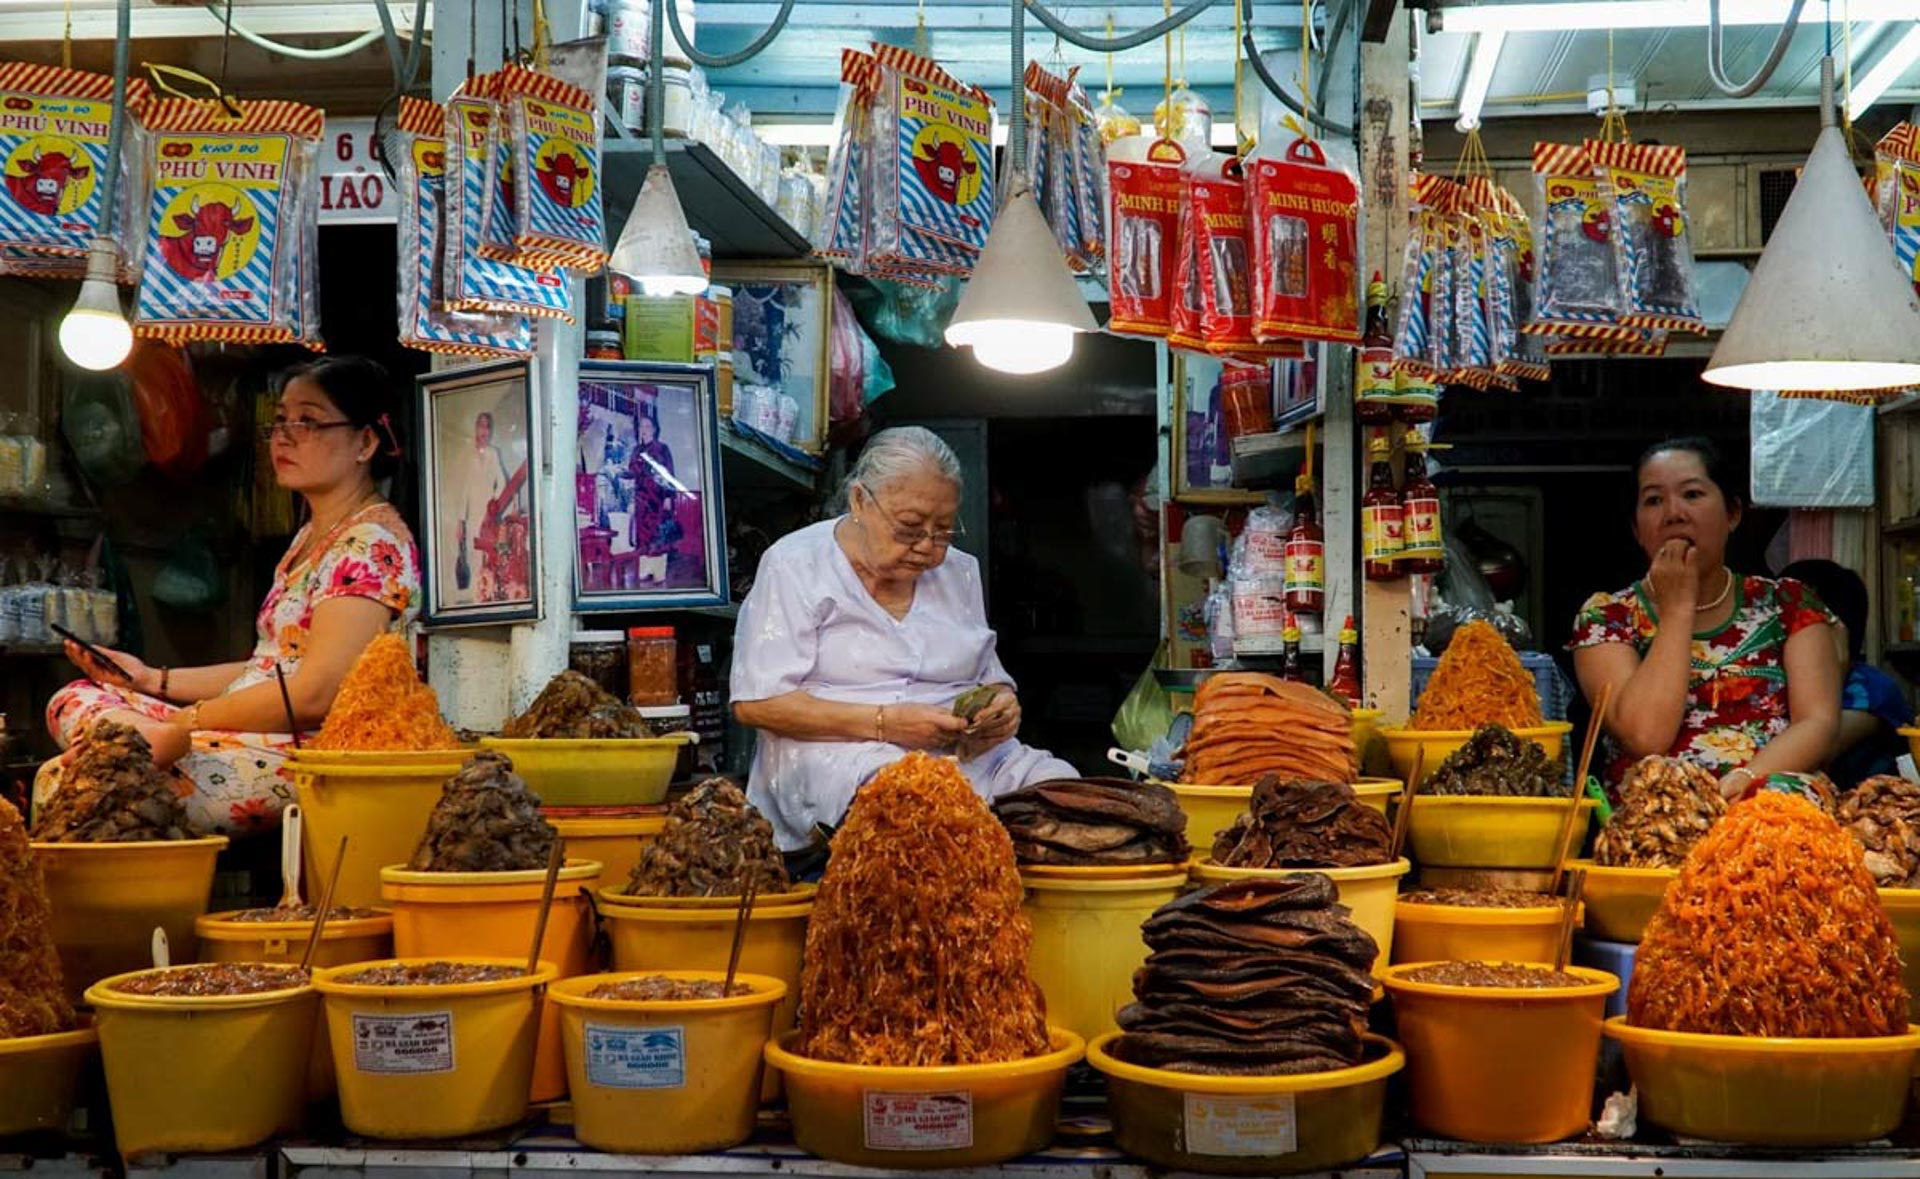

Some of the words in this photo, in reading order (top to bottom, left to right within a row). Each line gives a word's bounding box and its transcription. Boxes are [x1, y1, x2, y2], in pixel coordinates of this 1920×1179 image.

[54, 118, 108, 138] VINH
[946, 109, 987, 136] VINH
[336, 131, 354, 162] 6
[215, 161, 278, 180] VINH
[1120, 193, 1164, 213] MINH
[1268, 191, 1310, 211] MINH
